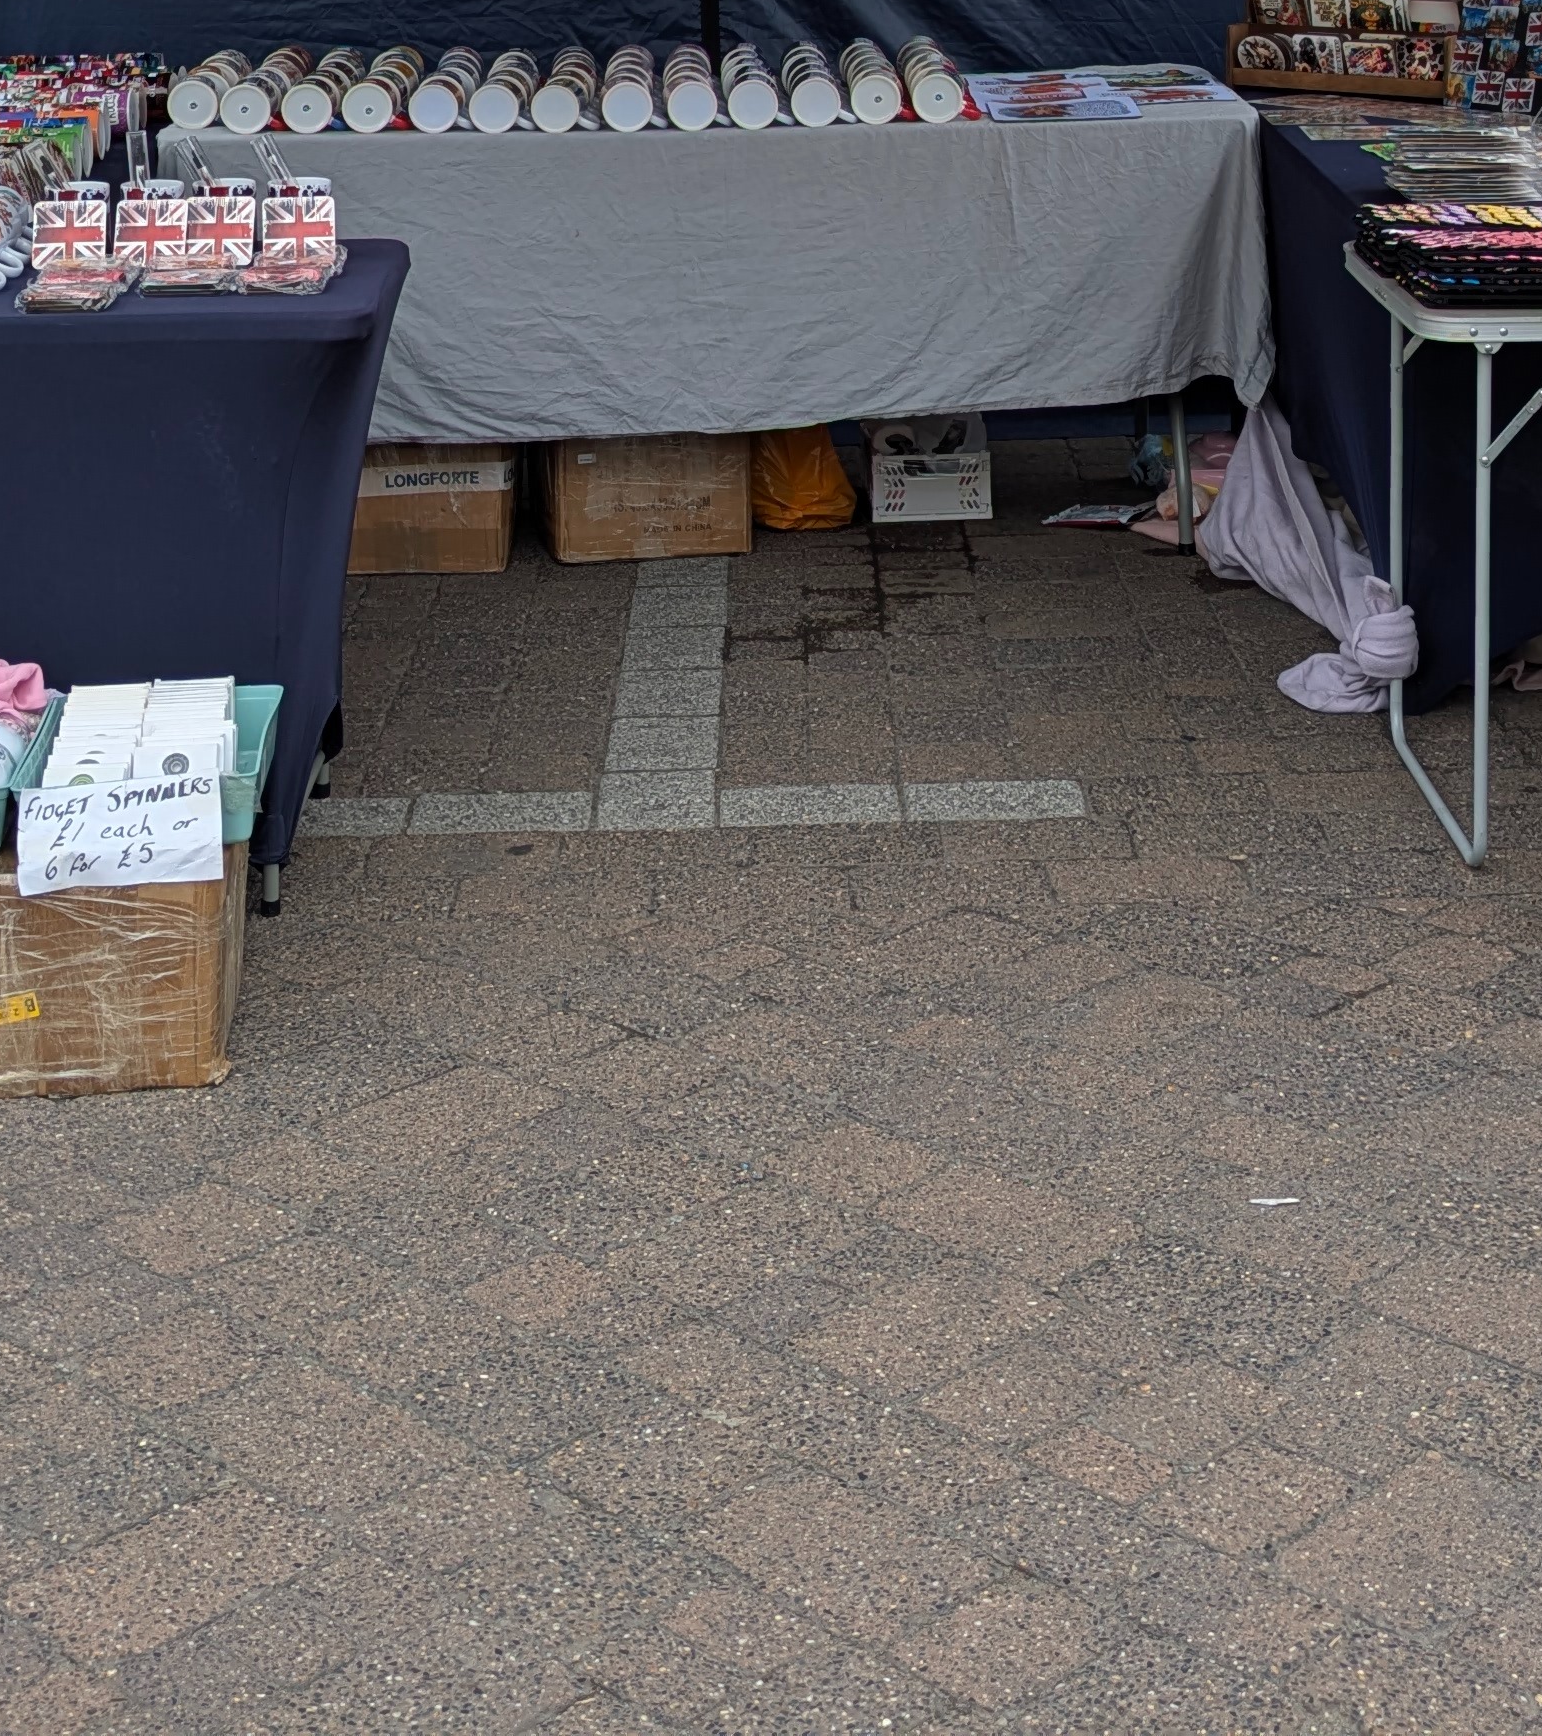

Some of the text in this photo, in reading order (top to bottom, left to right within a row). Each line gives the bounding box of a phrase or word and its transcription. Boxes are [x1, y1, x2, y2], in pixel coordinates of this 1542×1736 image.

[385, 470, 479, 488] LONGFORTE
[685, 523, 712, 531] CHINA
[108, 776, 213, 813] SPINNERS
[50, 814, 198, 851] £1 each or
[45, 842, 155, 880] 6 for £5
